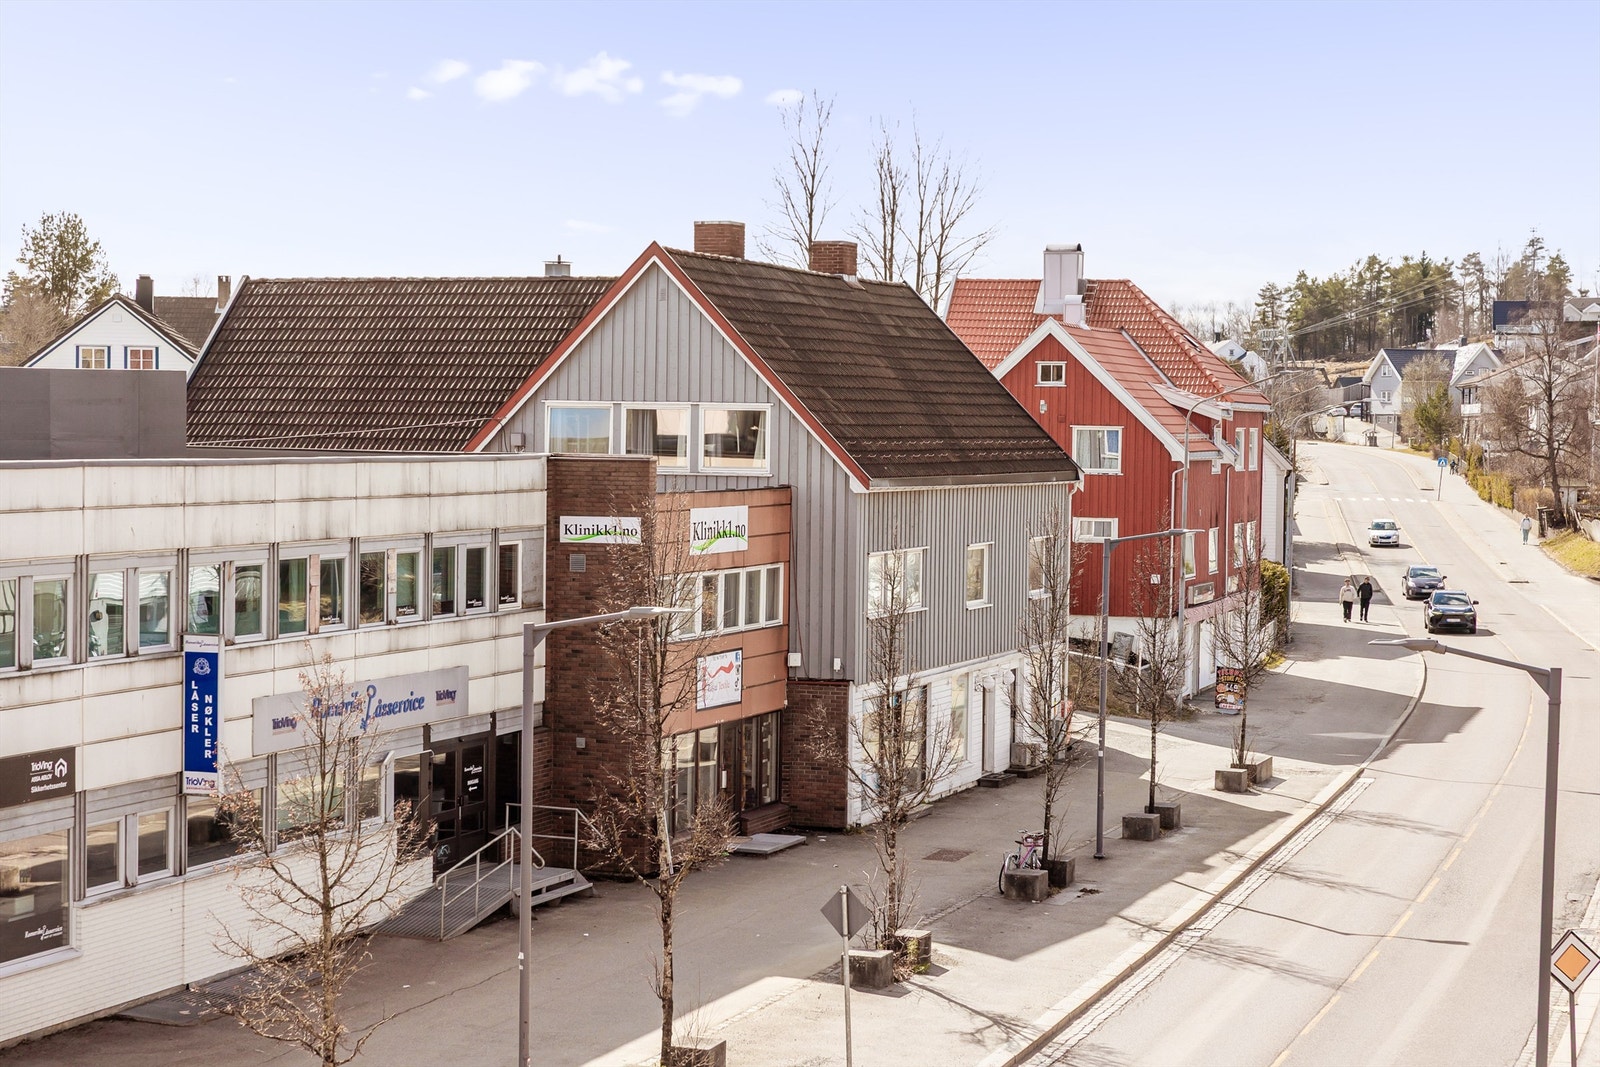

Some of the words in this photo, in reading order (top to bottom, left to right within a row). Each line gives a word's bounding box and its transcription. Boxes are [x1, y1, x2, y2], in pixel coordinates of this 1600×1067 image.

[564, 524, 638, 537] Klinikk1.no
[693, 520, 746, 541] Klinikk1.no
[204, 694, 213, 758] NØKLER
[31, 761, 53, 771] TrioVing
